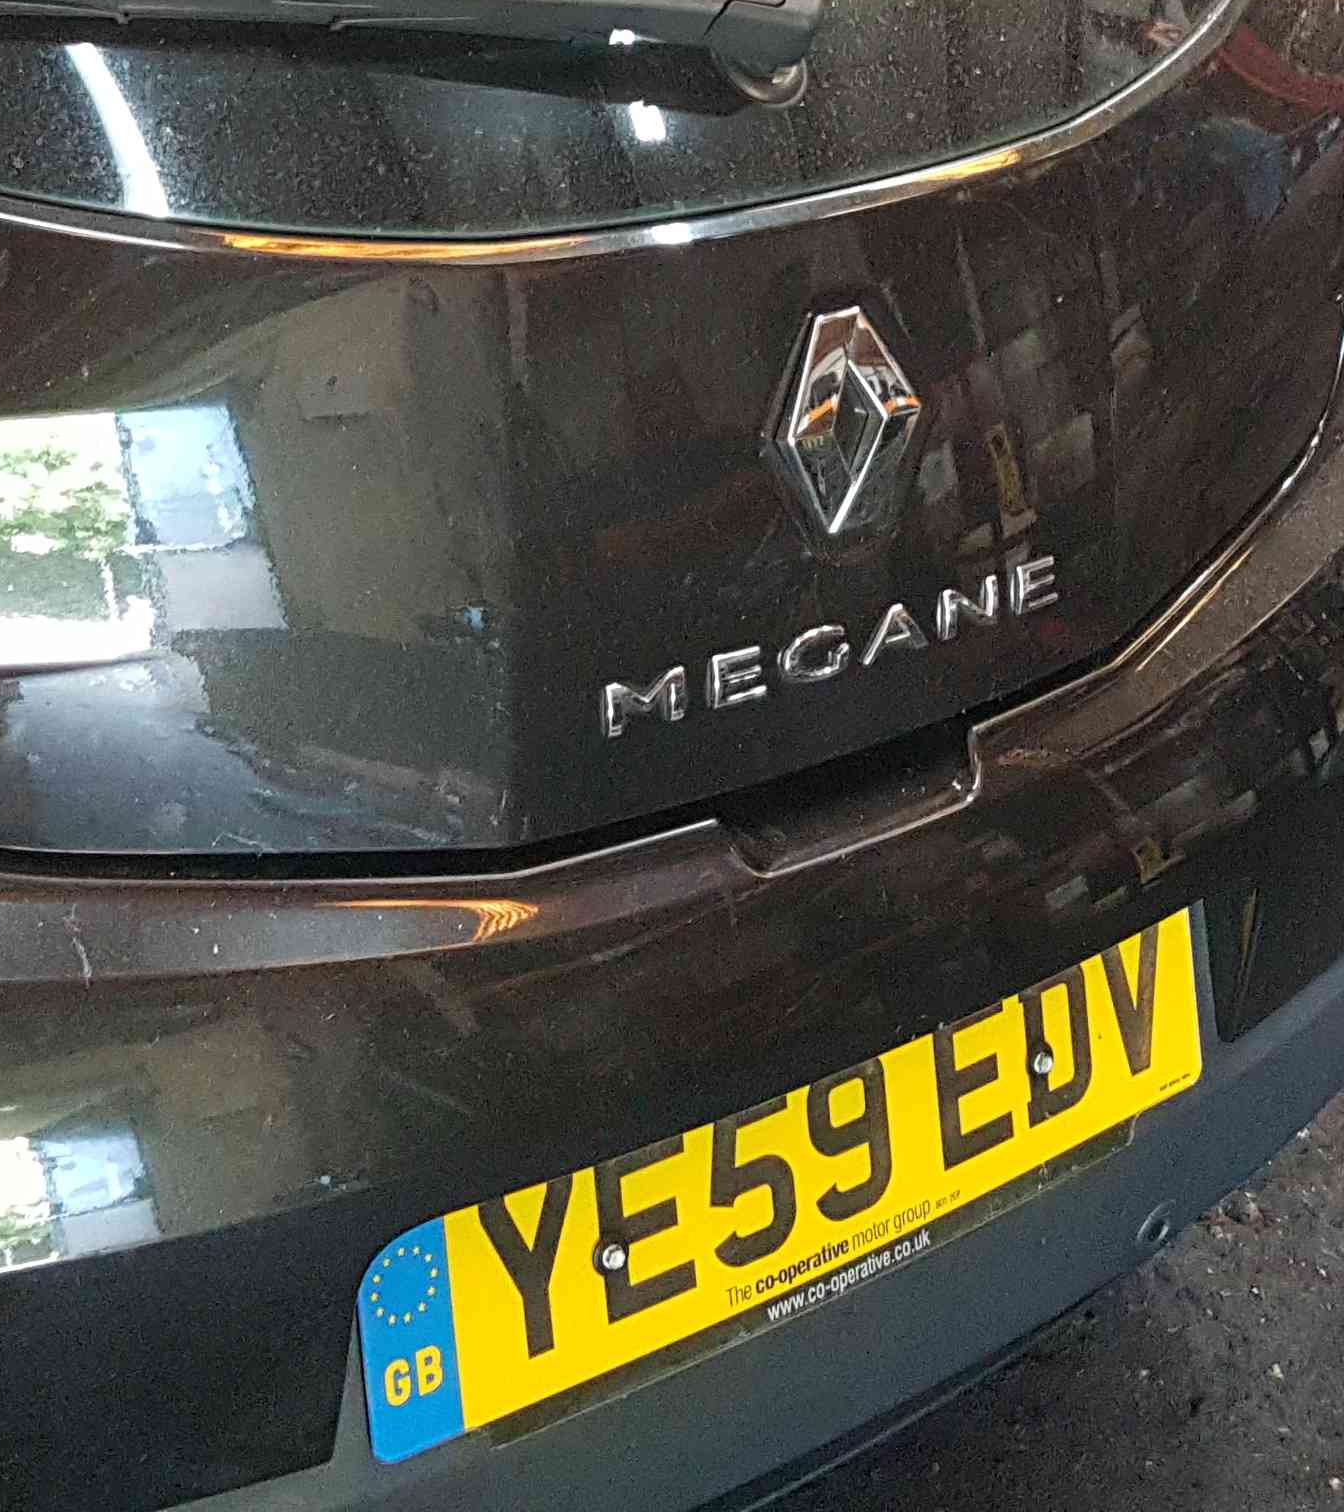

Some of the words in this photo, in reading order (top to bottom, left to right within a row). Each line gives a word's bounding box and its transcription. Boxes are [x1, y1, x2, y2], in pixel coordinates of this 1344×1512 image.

[601, 556, 1058, 738] MEGANE
[477, 1057, 893, 1359] YE59
[934, 926, 1157, 1171] EDV
[726, 1283, 752, 1308] The
[756, 1239, 849, 1294] co-operative
[852, 1219, 891, 1250] motor
[894, 1199, 932, 1233] group
[768, 1229, 931, 1321] www.co-operative.co.uk
[384, 1344, 443, 1407] GB
